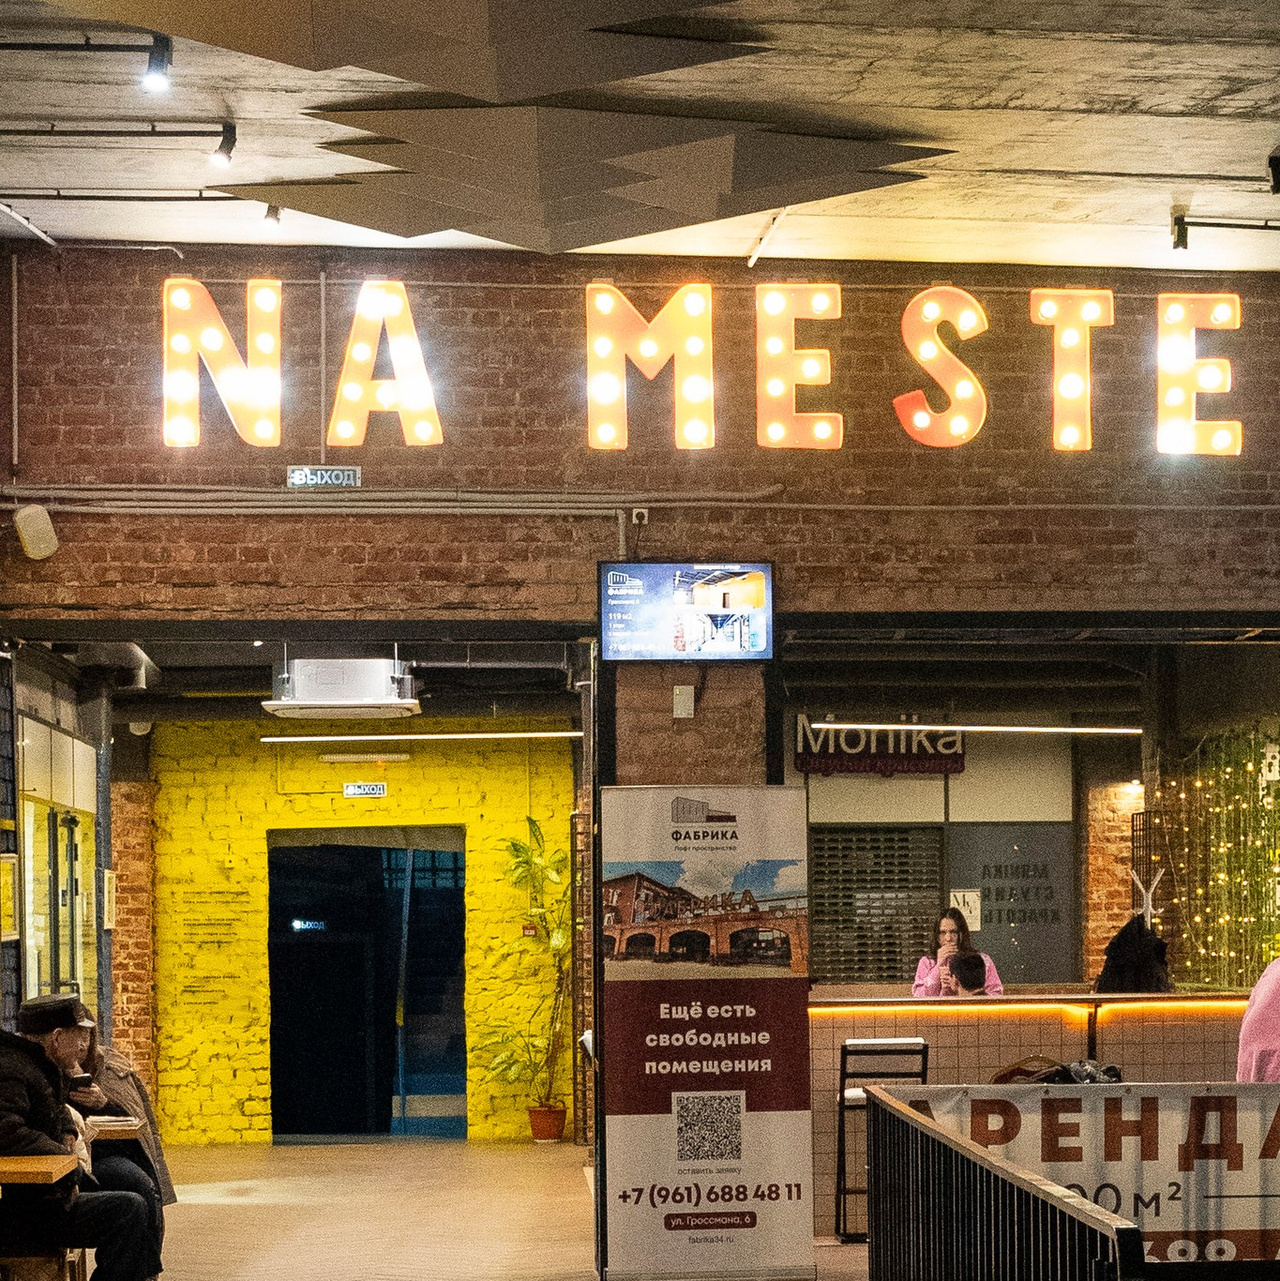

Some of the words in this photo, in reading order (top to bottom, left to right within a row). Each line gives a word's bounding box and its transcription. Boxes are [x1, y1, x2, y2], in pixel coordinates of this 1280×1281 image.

[163, 277, 443, 447] NA
[586, 282, 1243, 455] MESTE
[293, 469, 354, 486] ВЫХОД
[796, 713, 963, 754] Monika
[671, 829, 739, 842] ФАБРИКА
[660, 1000, 703, 1022] Ещё
[707, 1004, 756, 1018] есть
[645, 1028, 771, 1049] свободные
[644, 1057, 772, 1078] помещения
[618, 1187, 644, 1205] +7
[649, 1183, 702, 1208] (961)
[706, 1185, 748, 1203] 688
[752, 1184, 781, 1201] 48
[785, 1183, 802, 1200] 11
[744, 1216, 751, 1224] 6
